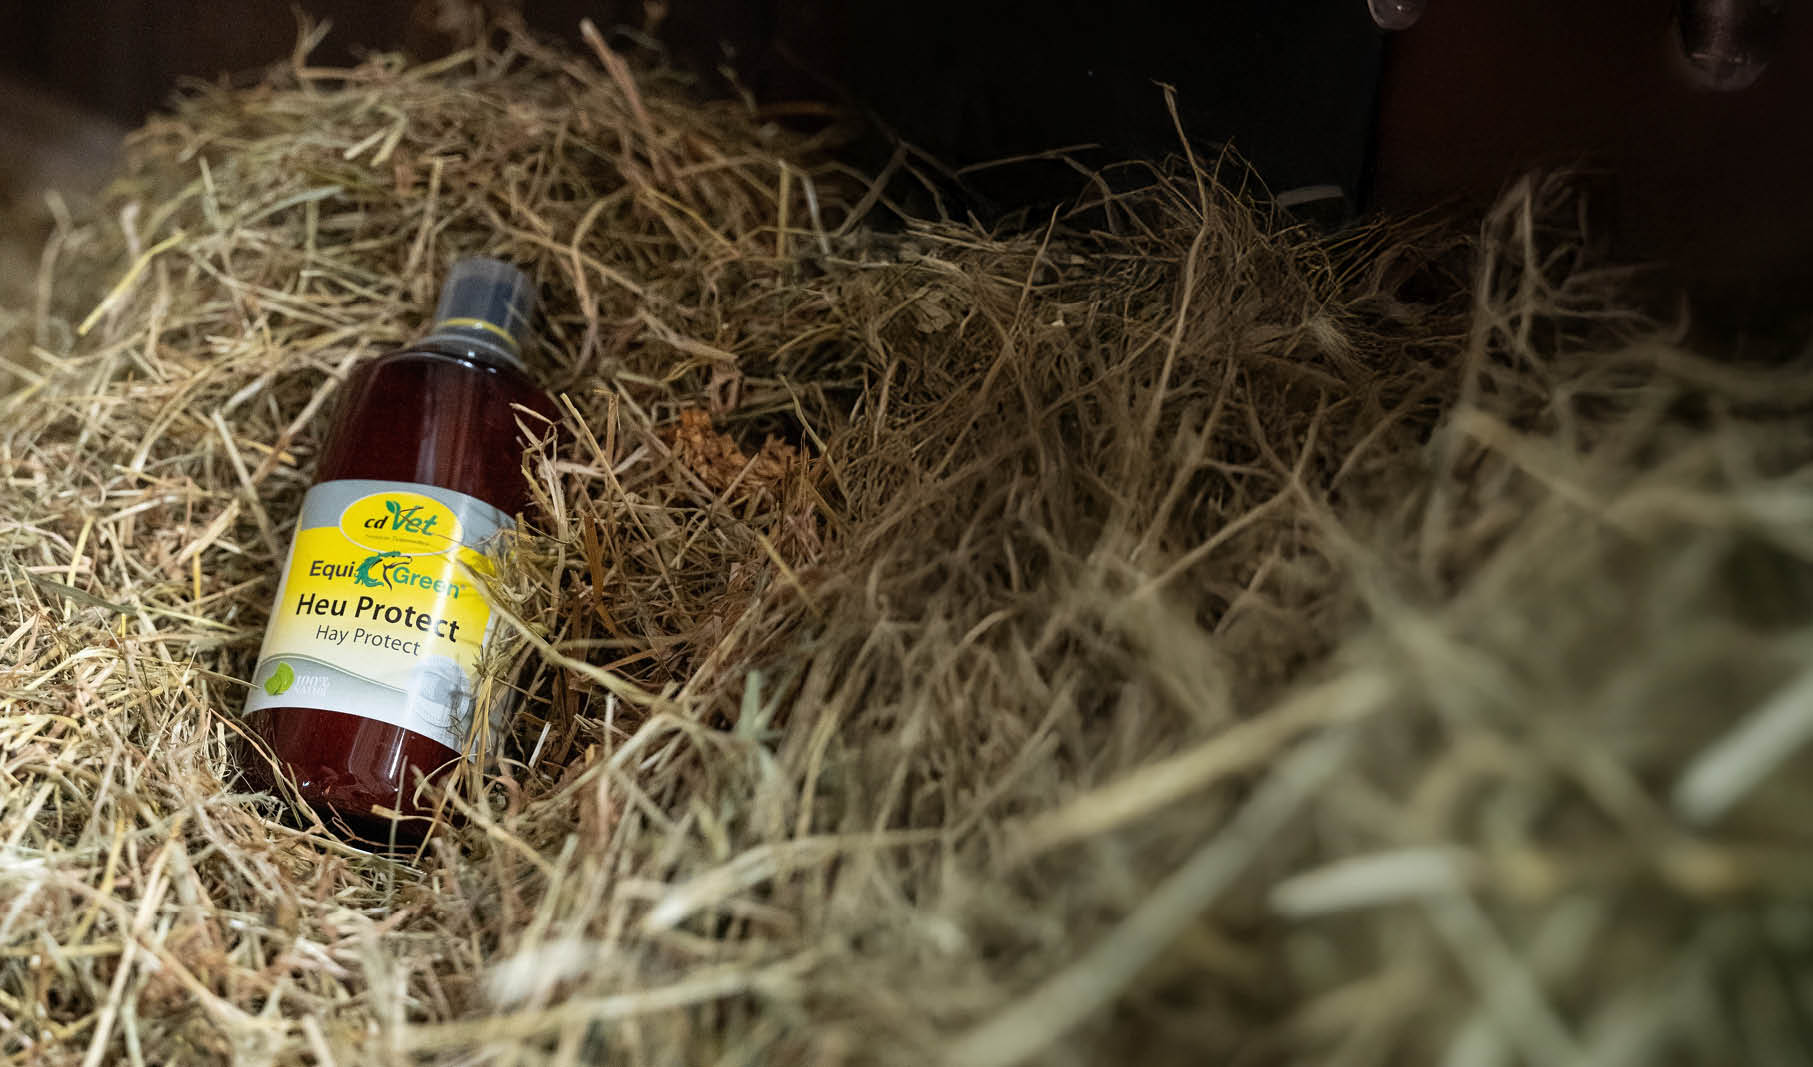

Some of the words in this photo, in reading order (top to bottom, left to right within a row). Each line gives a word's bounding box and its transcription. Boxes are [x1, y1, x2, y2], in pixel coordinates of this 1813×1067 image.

[364, 516, 388, 529] cd
[387, 501, 437, 535] Vet
[310, 560, 355, 580] Equi
[296, 593, 347, 615] Heu
[355, 596, 460, 643] Protect
[316, 624, 348, 646] Hay
[353, 628, 420, 656] Protect
